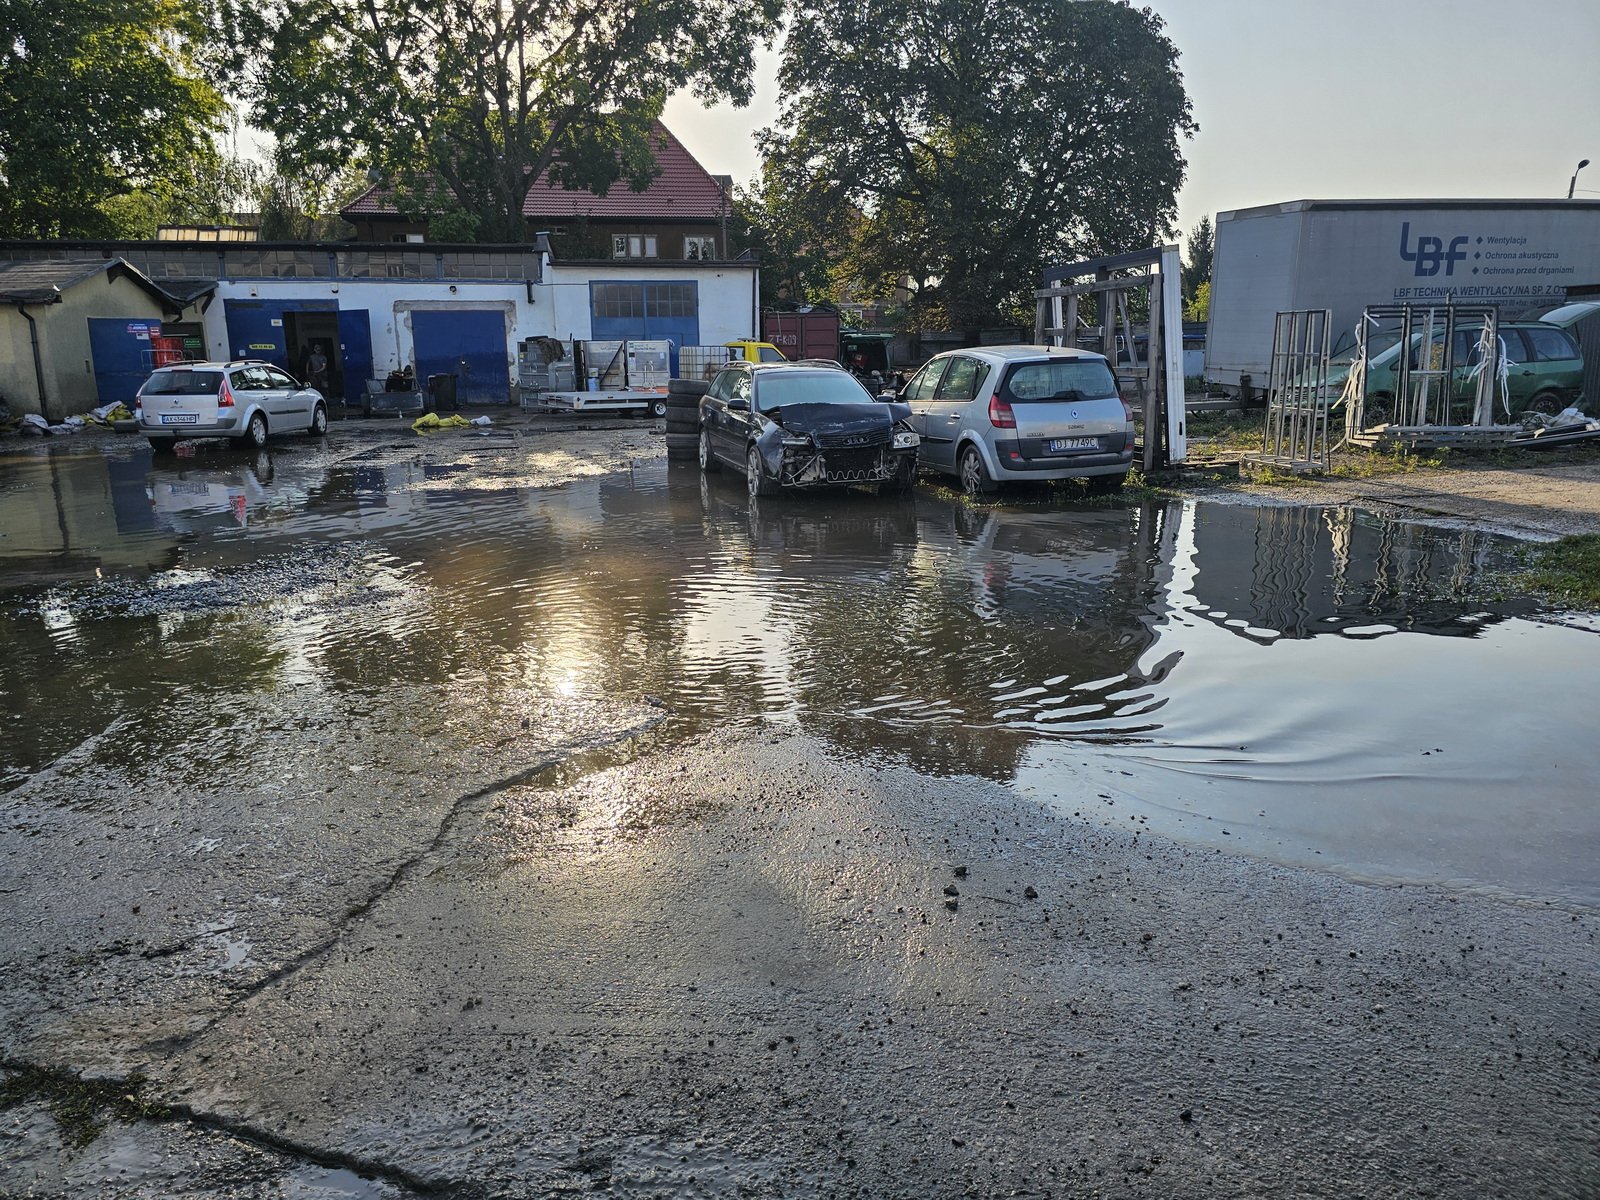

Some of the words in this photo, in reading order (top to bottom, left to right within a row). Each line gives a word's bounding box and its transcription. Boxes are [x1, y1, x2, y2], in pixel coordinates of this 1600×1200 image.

[1487, 236, 1527, 245] Wentylacja
[1485, 252, 1516, 260] Ochrona
[1518, 251, 1559, 261] akustyczna
[1483, 267, 1514, 275] Ochrona
[1516, 267, 1536, 276] przed
[1537, 266, 1575, 276] drganiami
[1393, 287, 1411, 298] LBF
[1412, 287, 1458, 297] TECHNIKA
[1460, 286, 1530, 296] WENTYLACYJNA
[1531, 286, 1544, 295] SP.
[1545, 286, 1553, 295] Z
